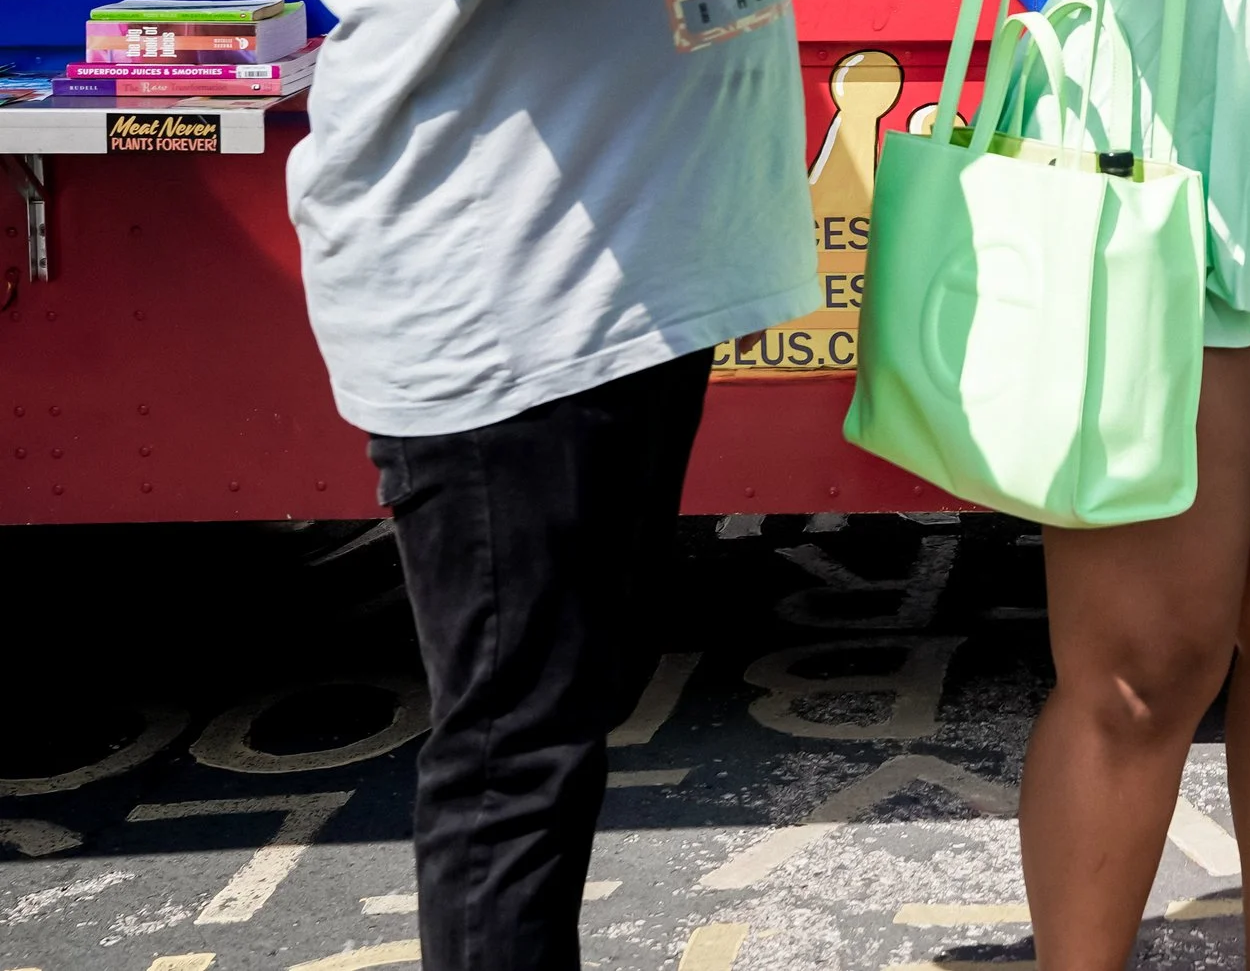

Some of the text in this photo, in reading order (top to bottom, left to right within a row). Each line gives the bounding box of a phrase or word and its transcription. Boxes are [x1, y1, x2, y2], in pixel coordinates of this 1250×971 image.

[77, 68, 223, 76] SUPERFOOD JUICES & SMOOTHIES
[141, 81, 169, 94] Raw
[109, 115, 160, 137] Meat
[111, 137, 217, 152] PLANTS FOREVER!
